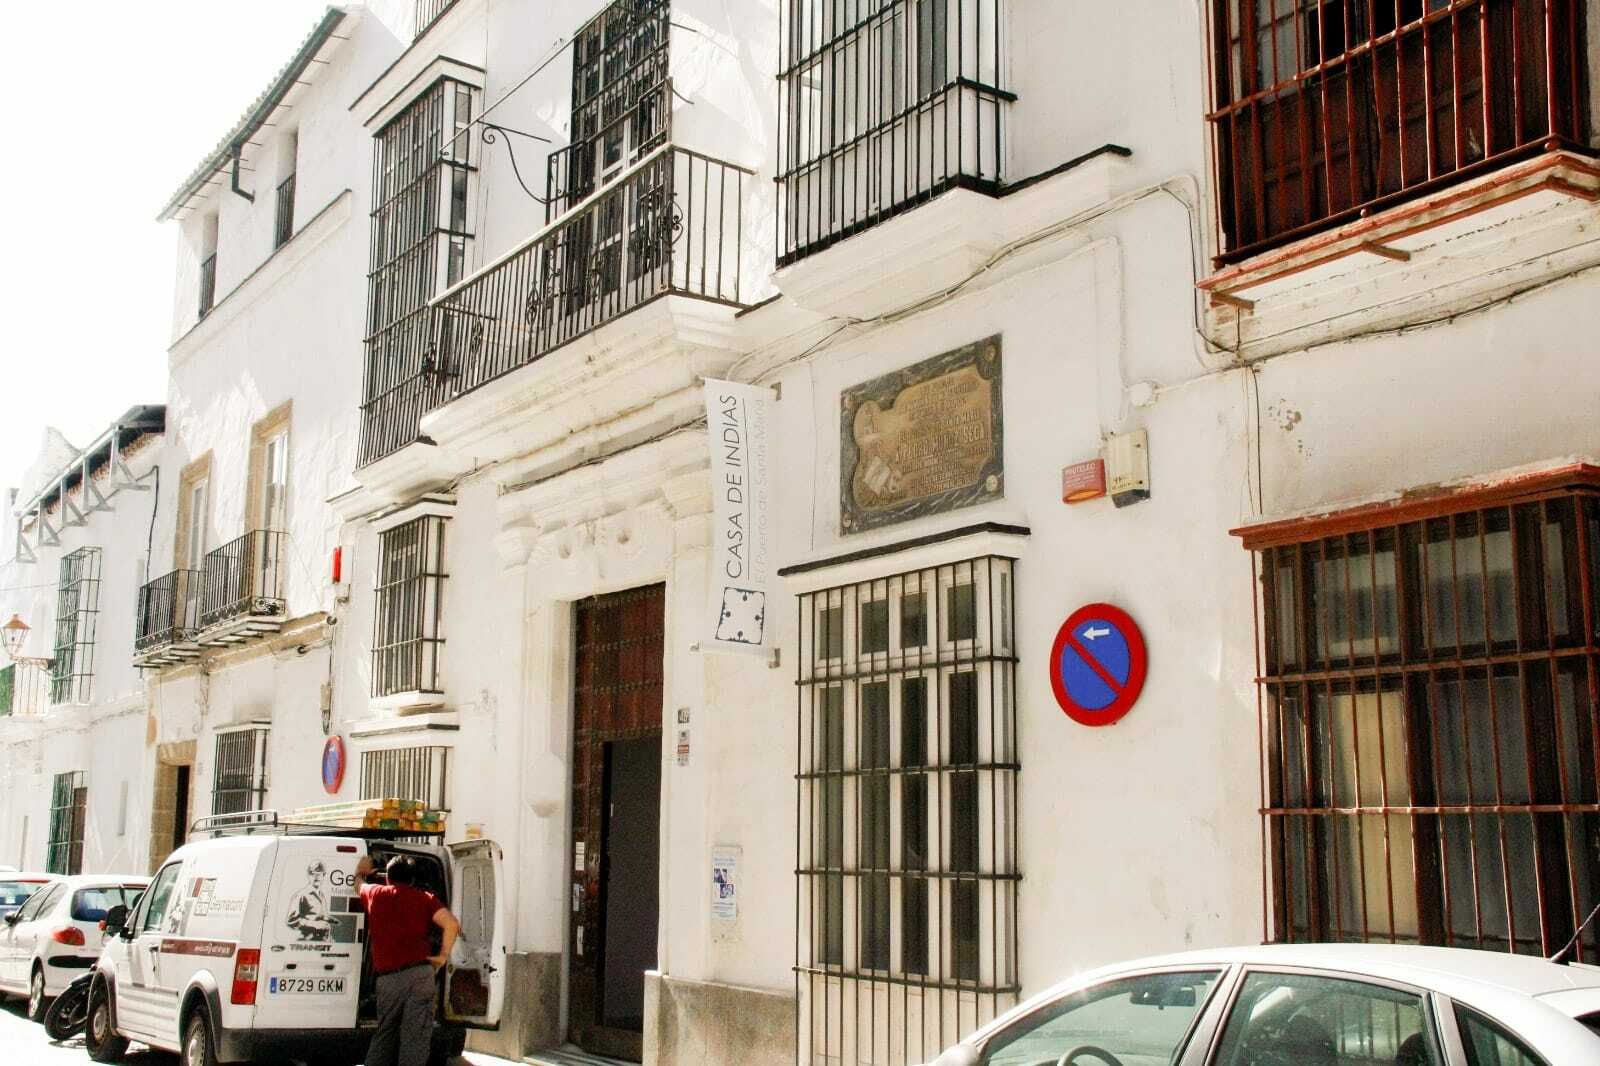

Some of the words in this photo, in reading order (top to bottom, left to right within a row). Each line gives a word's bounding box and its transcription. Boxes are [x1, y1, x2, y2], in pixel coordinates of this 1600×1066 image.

[719, 395, 742, 467] INDIAS
[726, 474, 743, 504] DE
[726, 512, 743, 579] CASA
[289, 943, 332, 952] TRANSIT
[279, 979, 314, 993] 8729
[318, 979, 344, 993] GKM
